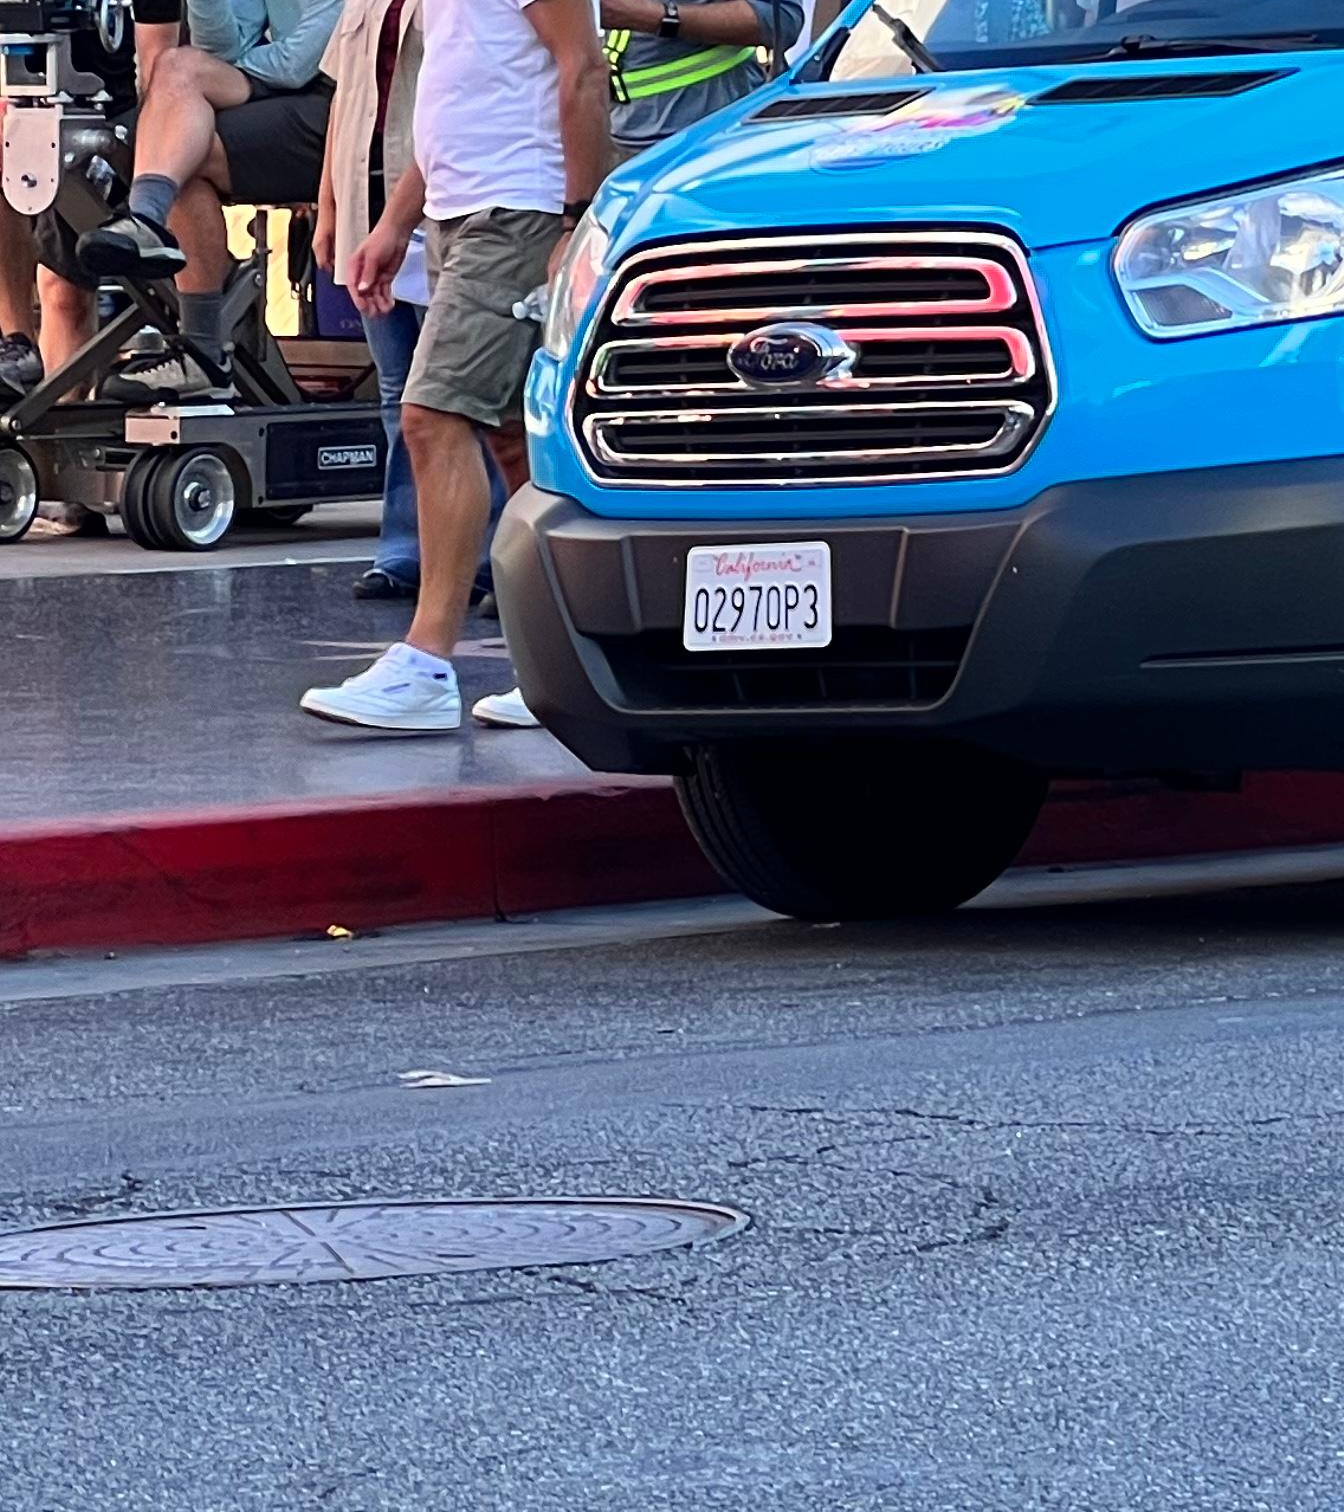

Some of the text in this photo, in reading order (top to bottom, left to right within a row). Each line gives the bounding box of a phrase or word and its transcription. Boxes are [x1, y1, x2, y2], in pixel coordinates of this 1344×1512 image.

[321, 450, 373, 465] CHAPMAN
[713, 551, 801, 582] California
[694, 584, 818, 633] 02970P3
